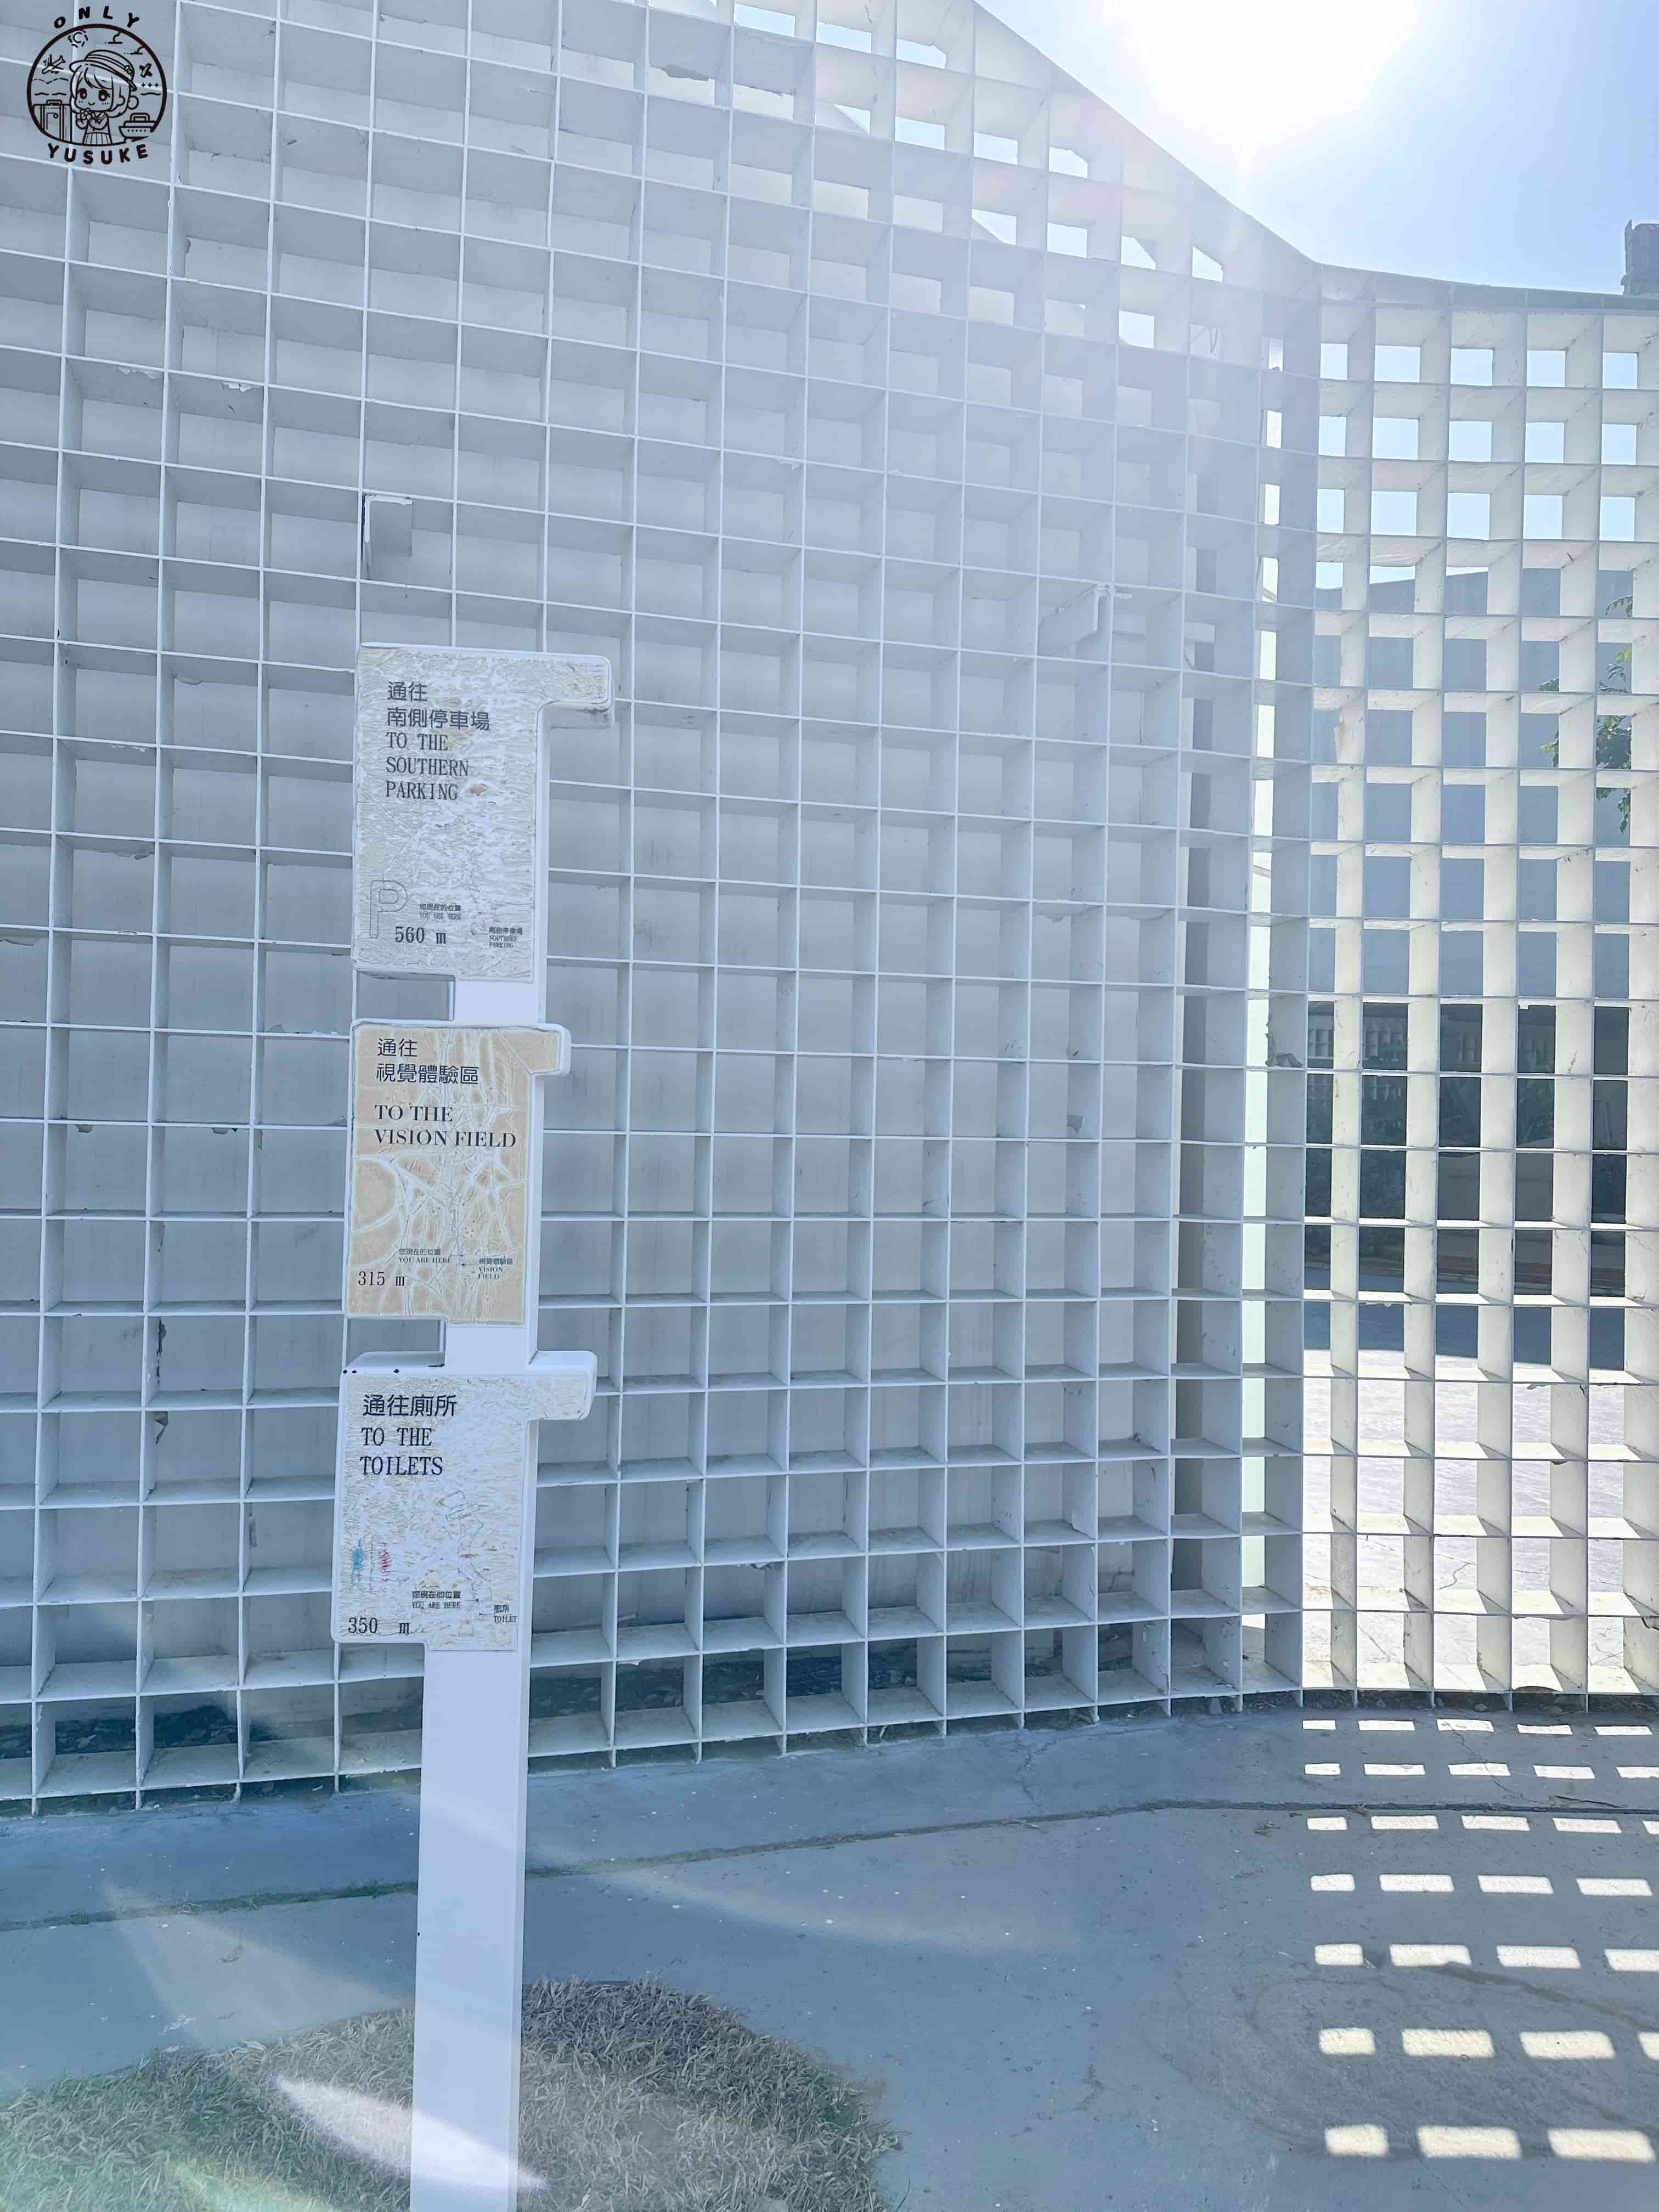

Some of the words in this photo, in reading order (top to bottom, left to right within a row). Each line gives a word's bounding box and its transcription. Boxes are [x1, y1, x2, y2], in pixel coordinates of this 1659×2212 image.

[387, 681, 427, 702] 通往
[387, 707, 490, 731] 南側停車場
[386, 732, 407, 748] TO
[417, 733, 448, 751] THE
[386, 756, 469, 776] SOUTHERN
[386, 781, 459, 800] PARKING
[395, 926, 425, 943] 560
[436, 933, 446, 944] m
[377, 1038, 417, 1057] 通往
[376, 1063, 479, 1085] 視覺體驗區
[375, 1105, 403, 1120] TO
[410, 1106, 453, 1122] THE
[375, 1129, 447, 1146] VISION
[455, 1131, 516, 1148] FIELD
[358, 1271, 385, 1286] 315
[395, 1276, 405, 1286] m
[362, 1394, 456, 1417] 通往廁所
[361, 1427, 384, 1446] TO
[397, 1427, 432, 1446] THE
[360, 1457, 443, 1476] TOILETS
[348, 1617, 378, 1634] 350
[399, 1622, 410, 1634] m
